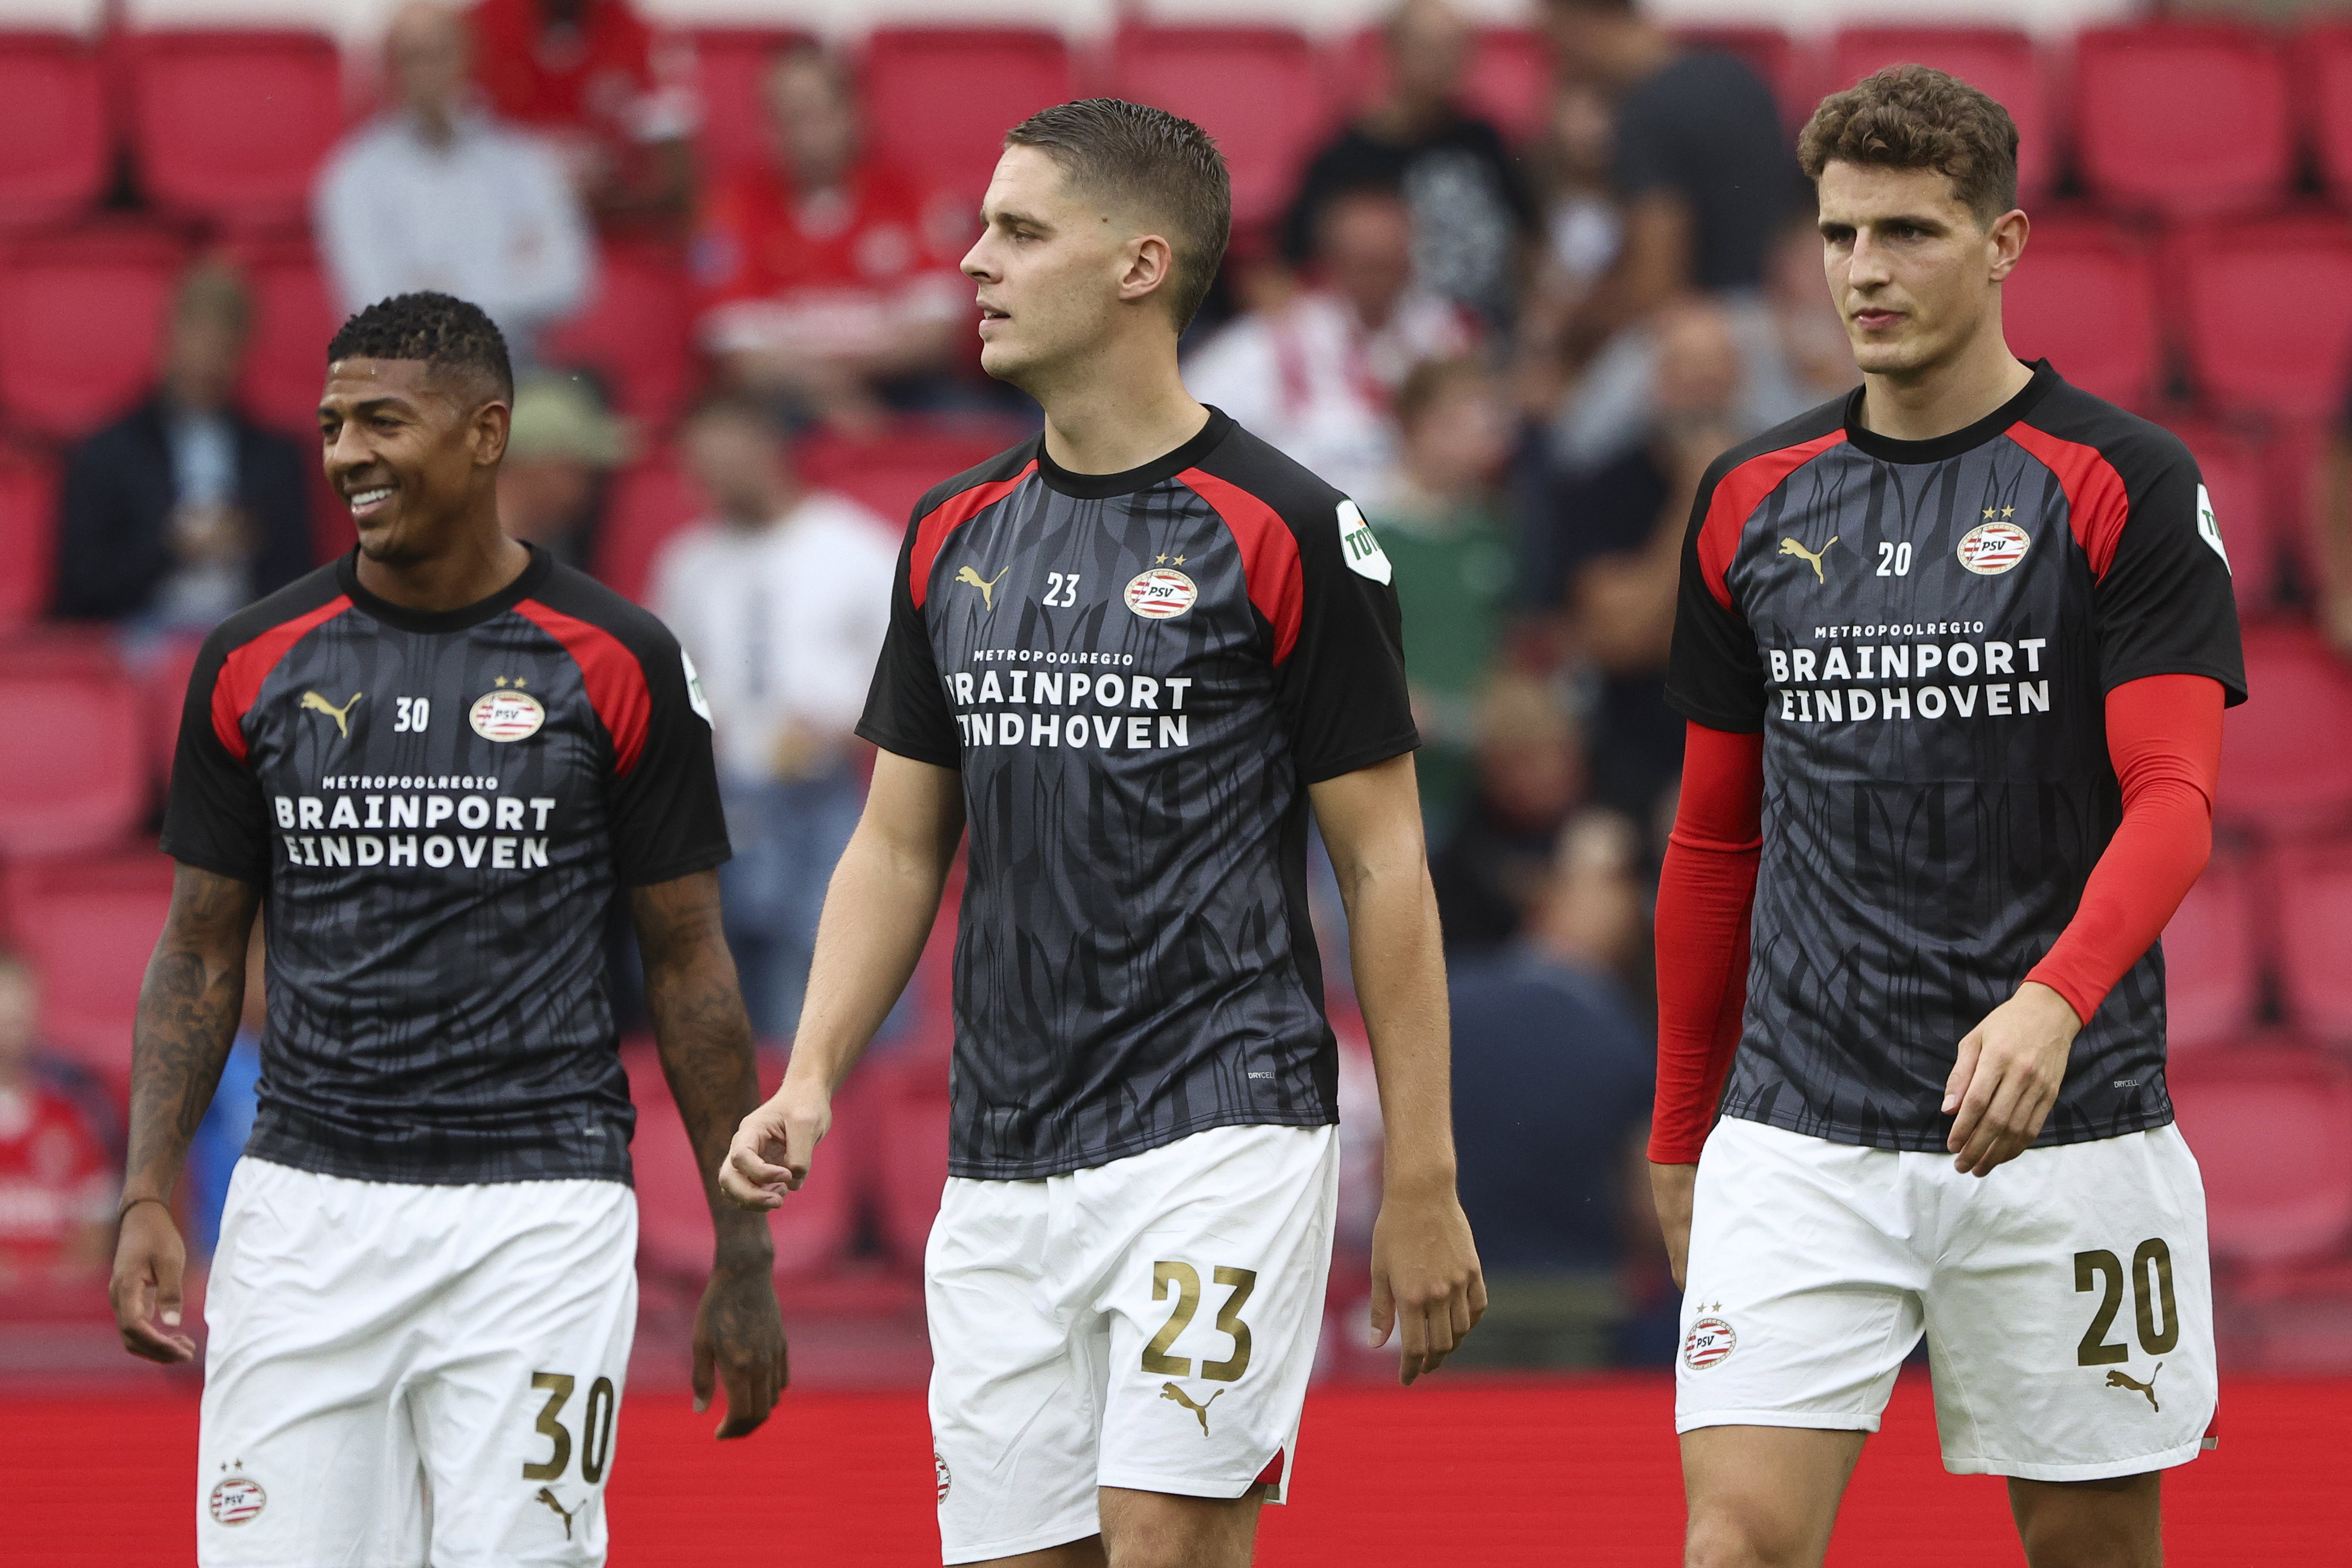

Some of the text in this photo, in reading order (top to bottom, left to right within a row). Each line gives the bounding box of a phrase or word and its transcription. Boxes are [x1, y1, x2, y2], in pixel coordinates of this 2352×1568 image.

[1876, 541, 1912, 576] 20
[1982, 540, 2006, 551] PSV
[1043, 572, 1080, 607] 23
[1148, 587, 1174, 597] PSV
[1815, 621, 1983, 638] METROPOOLREGIO
[973, 649, 1133, 666] METROPOOLREGIO
[1769, 638, 2047, 683] BRAINPORT
[394, 697, 429, 733] 30
[495, 710, 519, 719] PSV
[1780, 680, 2050, 722] EINDHOVEN
[322, 775, 498, 790] METROPOOLREGIO
[275, 795, 555, 831] BRAINPORT
[283, 835, 550, 869] EINDHOVEN
[2114, 1079, 2140, 1088] DRYCELL
[2074, 1238, 2179, 1366] 20
[1141, 1261, 1257, 1382] 23
[1696, 1335, 1715, 1349] PSV
[523, 1372, 614, 1484] 30
